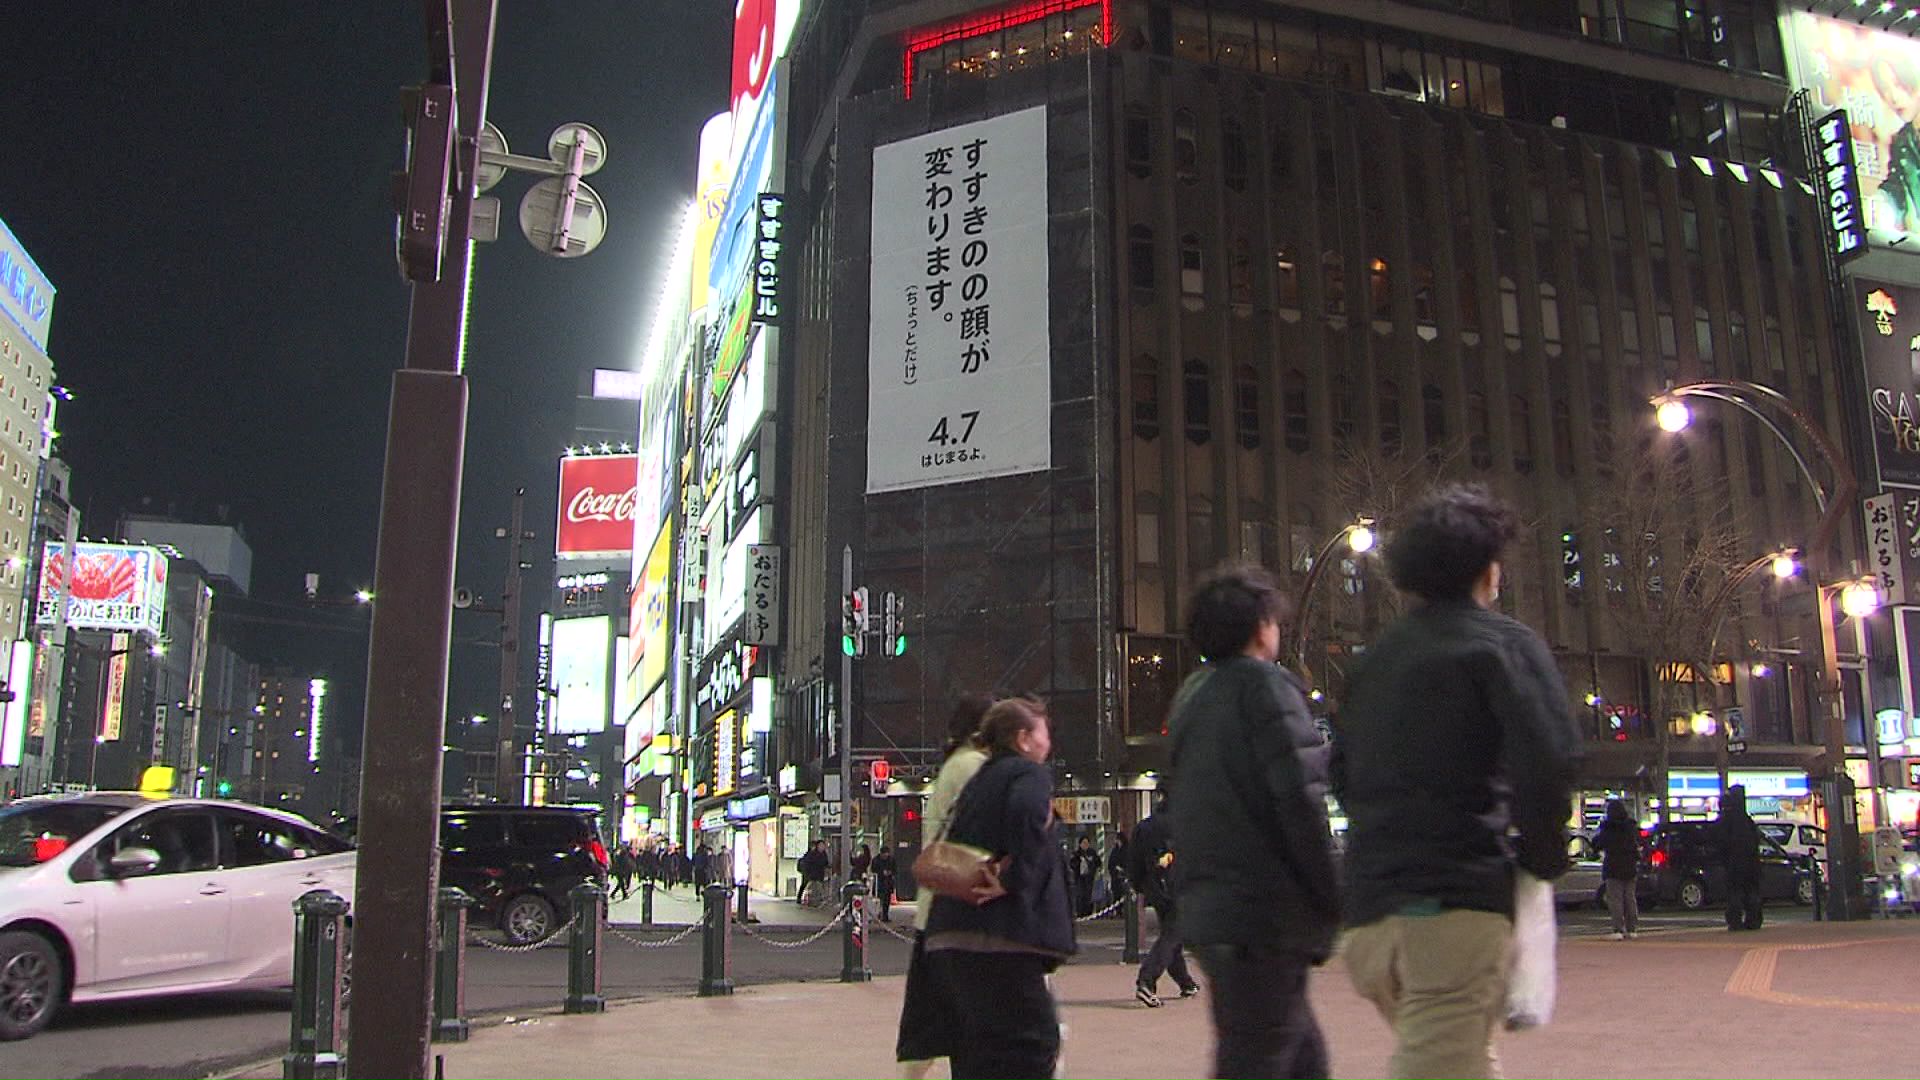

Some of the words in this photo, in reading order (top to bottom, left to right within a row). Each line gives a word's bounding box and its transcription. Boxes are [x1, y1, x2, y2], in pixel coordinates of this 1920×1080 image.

[925, 147, 954, 324] 変わります。
[960, 138, 990, 375] すすきのの顔が
[903, 284, 918, 387] （ちょっとだけ）
[920, 446, 988, 470] はじまるよ。
[927, 409, 981, 447] 4.7
